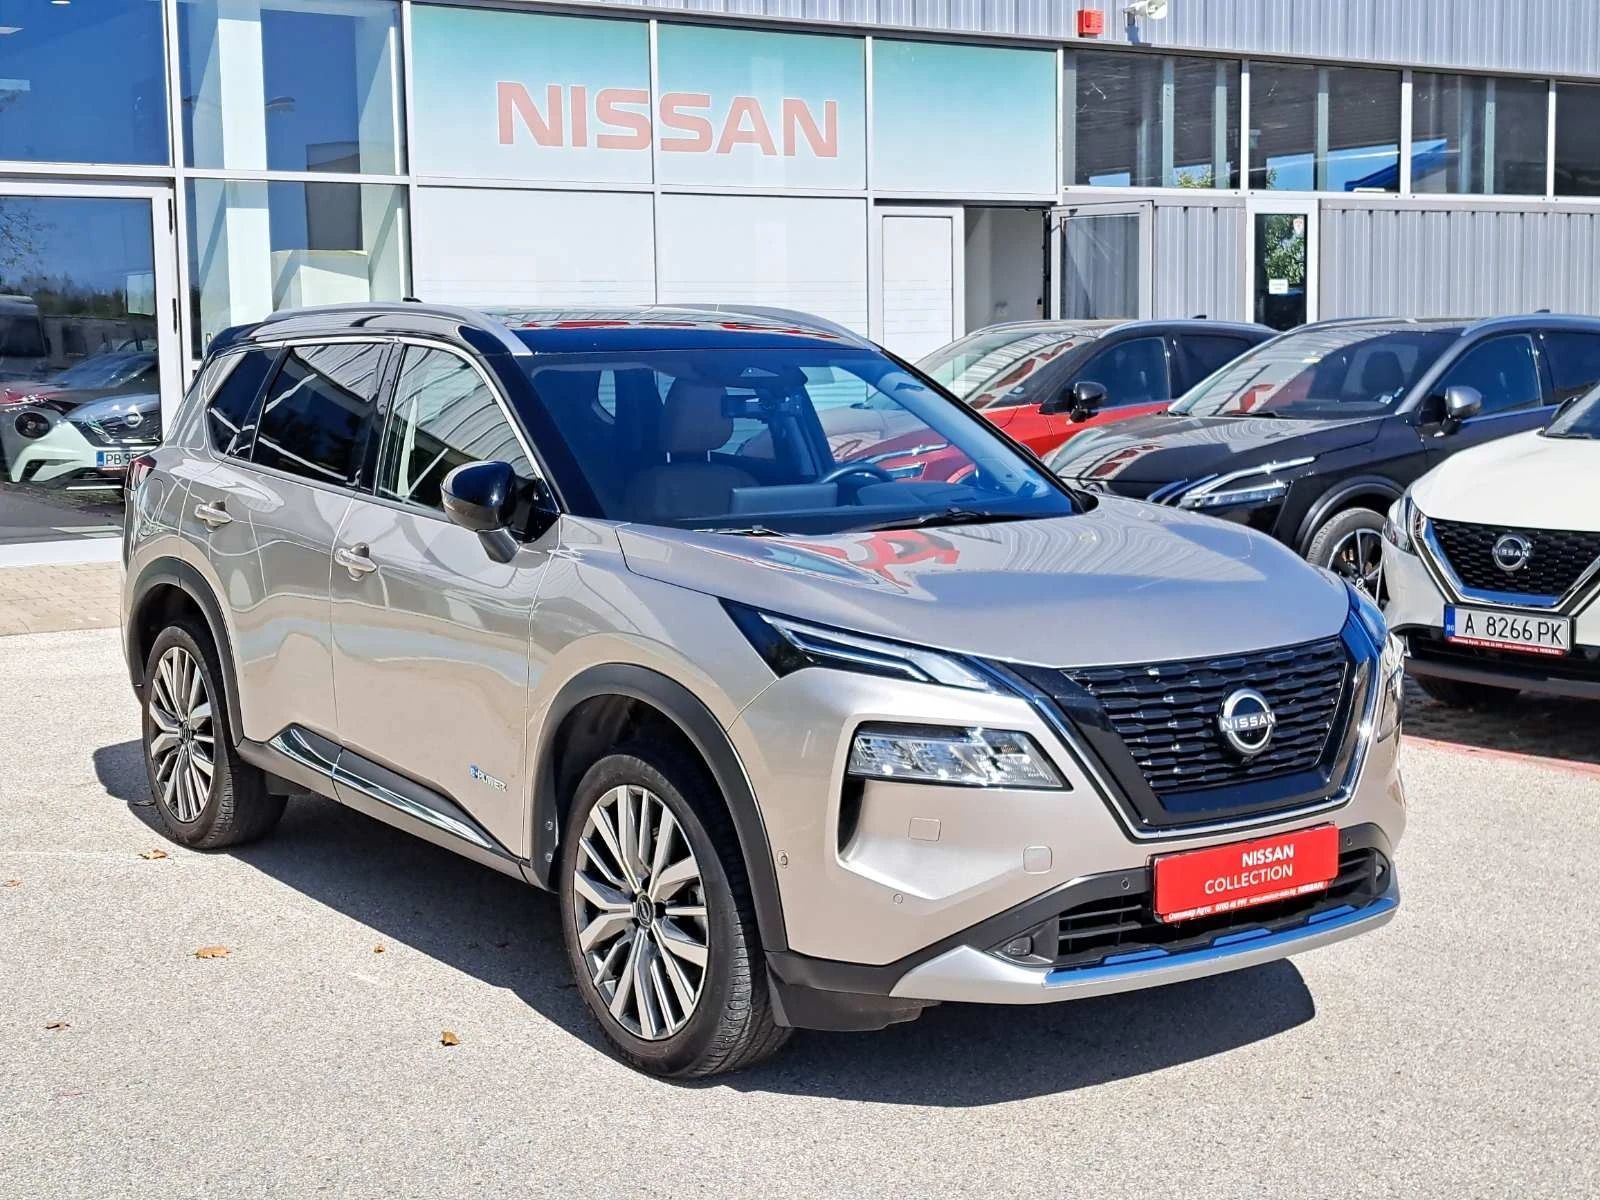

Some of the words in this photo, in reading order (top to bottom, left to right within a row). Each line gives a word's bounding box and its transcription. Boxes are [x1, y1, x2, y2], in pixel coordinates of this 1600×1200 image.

[496, 80, 838, 158] NISSAN
[105, 454, 121, 465] PB
[1464, 613, 1475, 635] A
[1486, 616, 1533, 641] 8266
[1537, 621, 1564, 645] PK
[1221, 711, 1276, 730] NISSAN
[1241, 843, 1294, 868] NISSAN
[1204, 863, 1293, 894] COLLECTION
